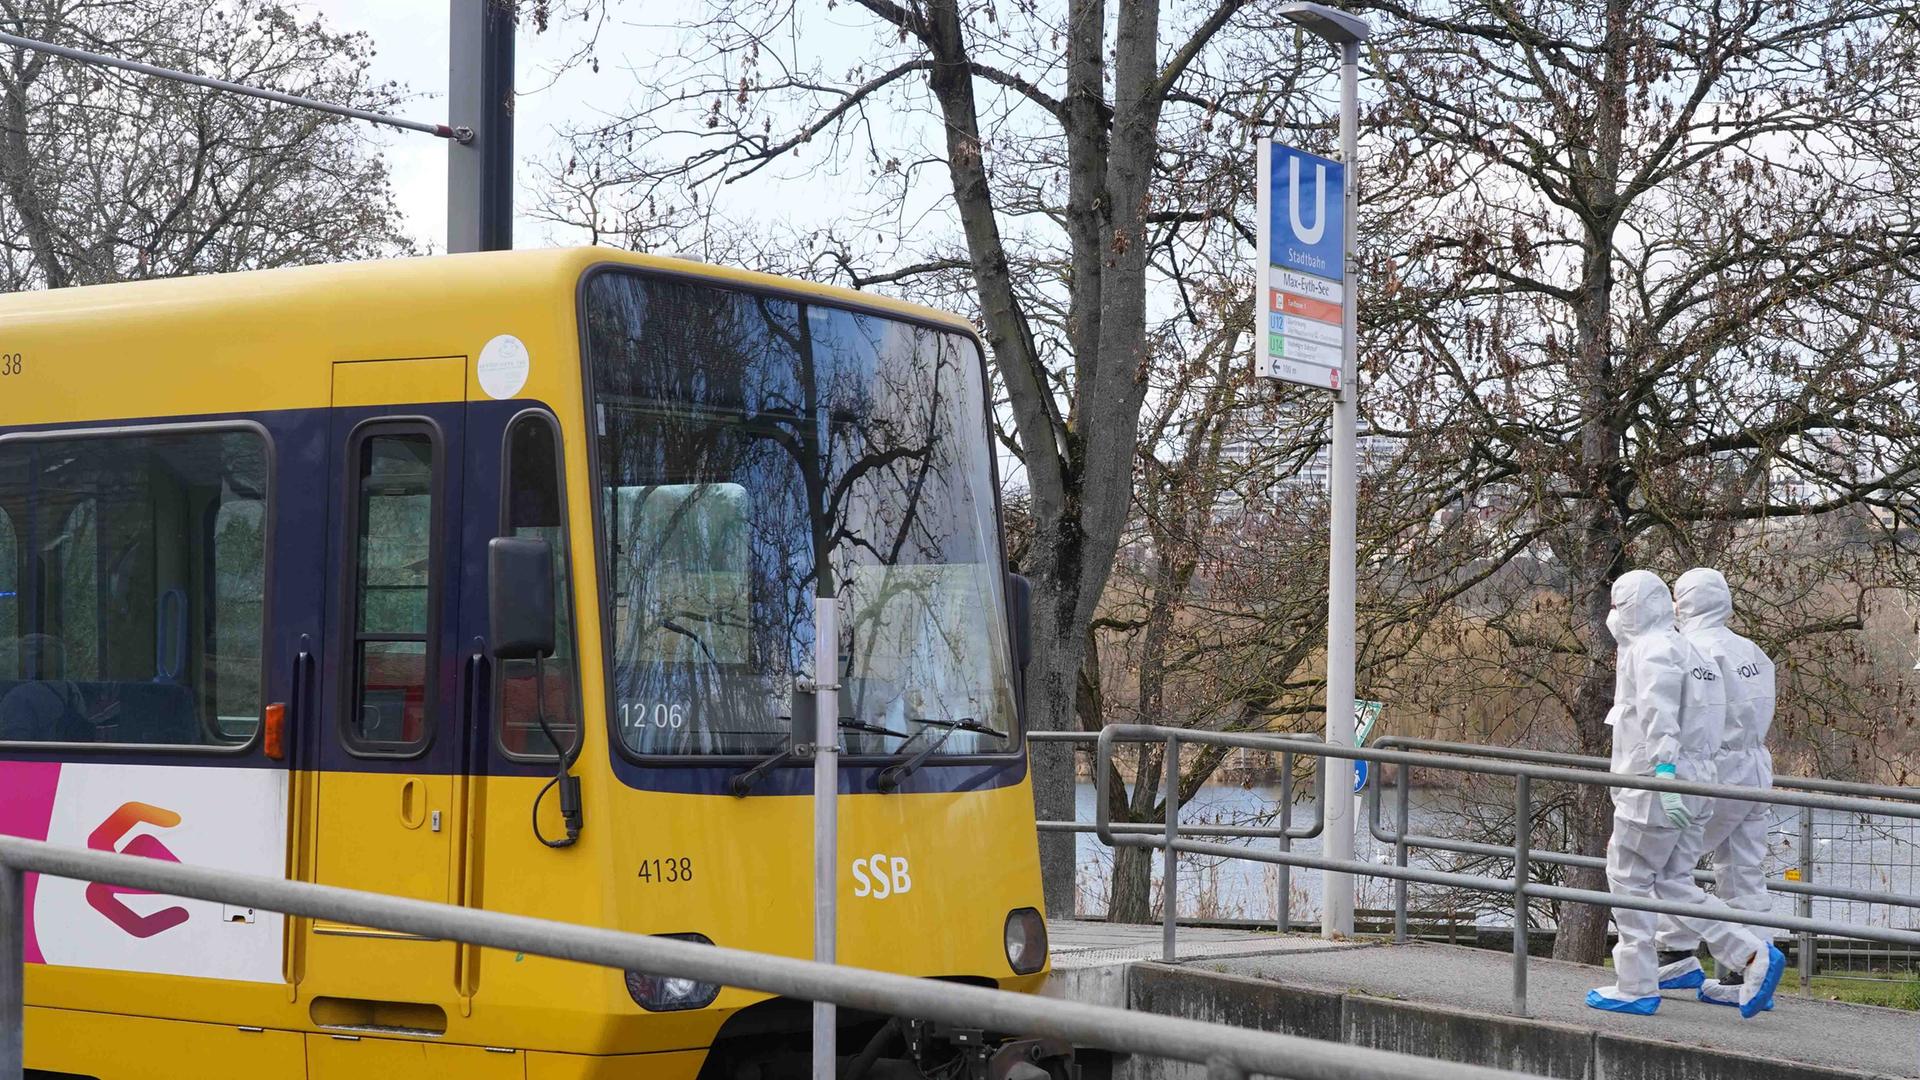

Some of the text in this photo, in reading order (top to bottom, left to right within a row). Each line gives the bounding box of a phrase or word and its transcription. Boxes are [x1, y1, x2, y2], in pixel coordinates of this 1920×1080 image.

[1289, 155, 1326, 245] U
[1288, 248, 1326, 270] Stadtbahn
[1283, 273, 1330, 296] Max-Eyth-See
[1270, 314, 1284, 330] U12
[1270, 336, 1283, 353] U14
[1, 353, 22, 376] 38
[638, 857, 693, 883] 4138
[852, 853, 911, 899] SSB
